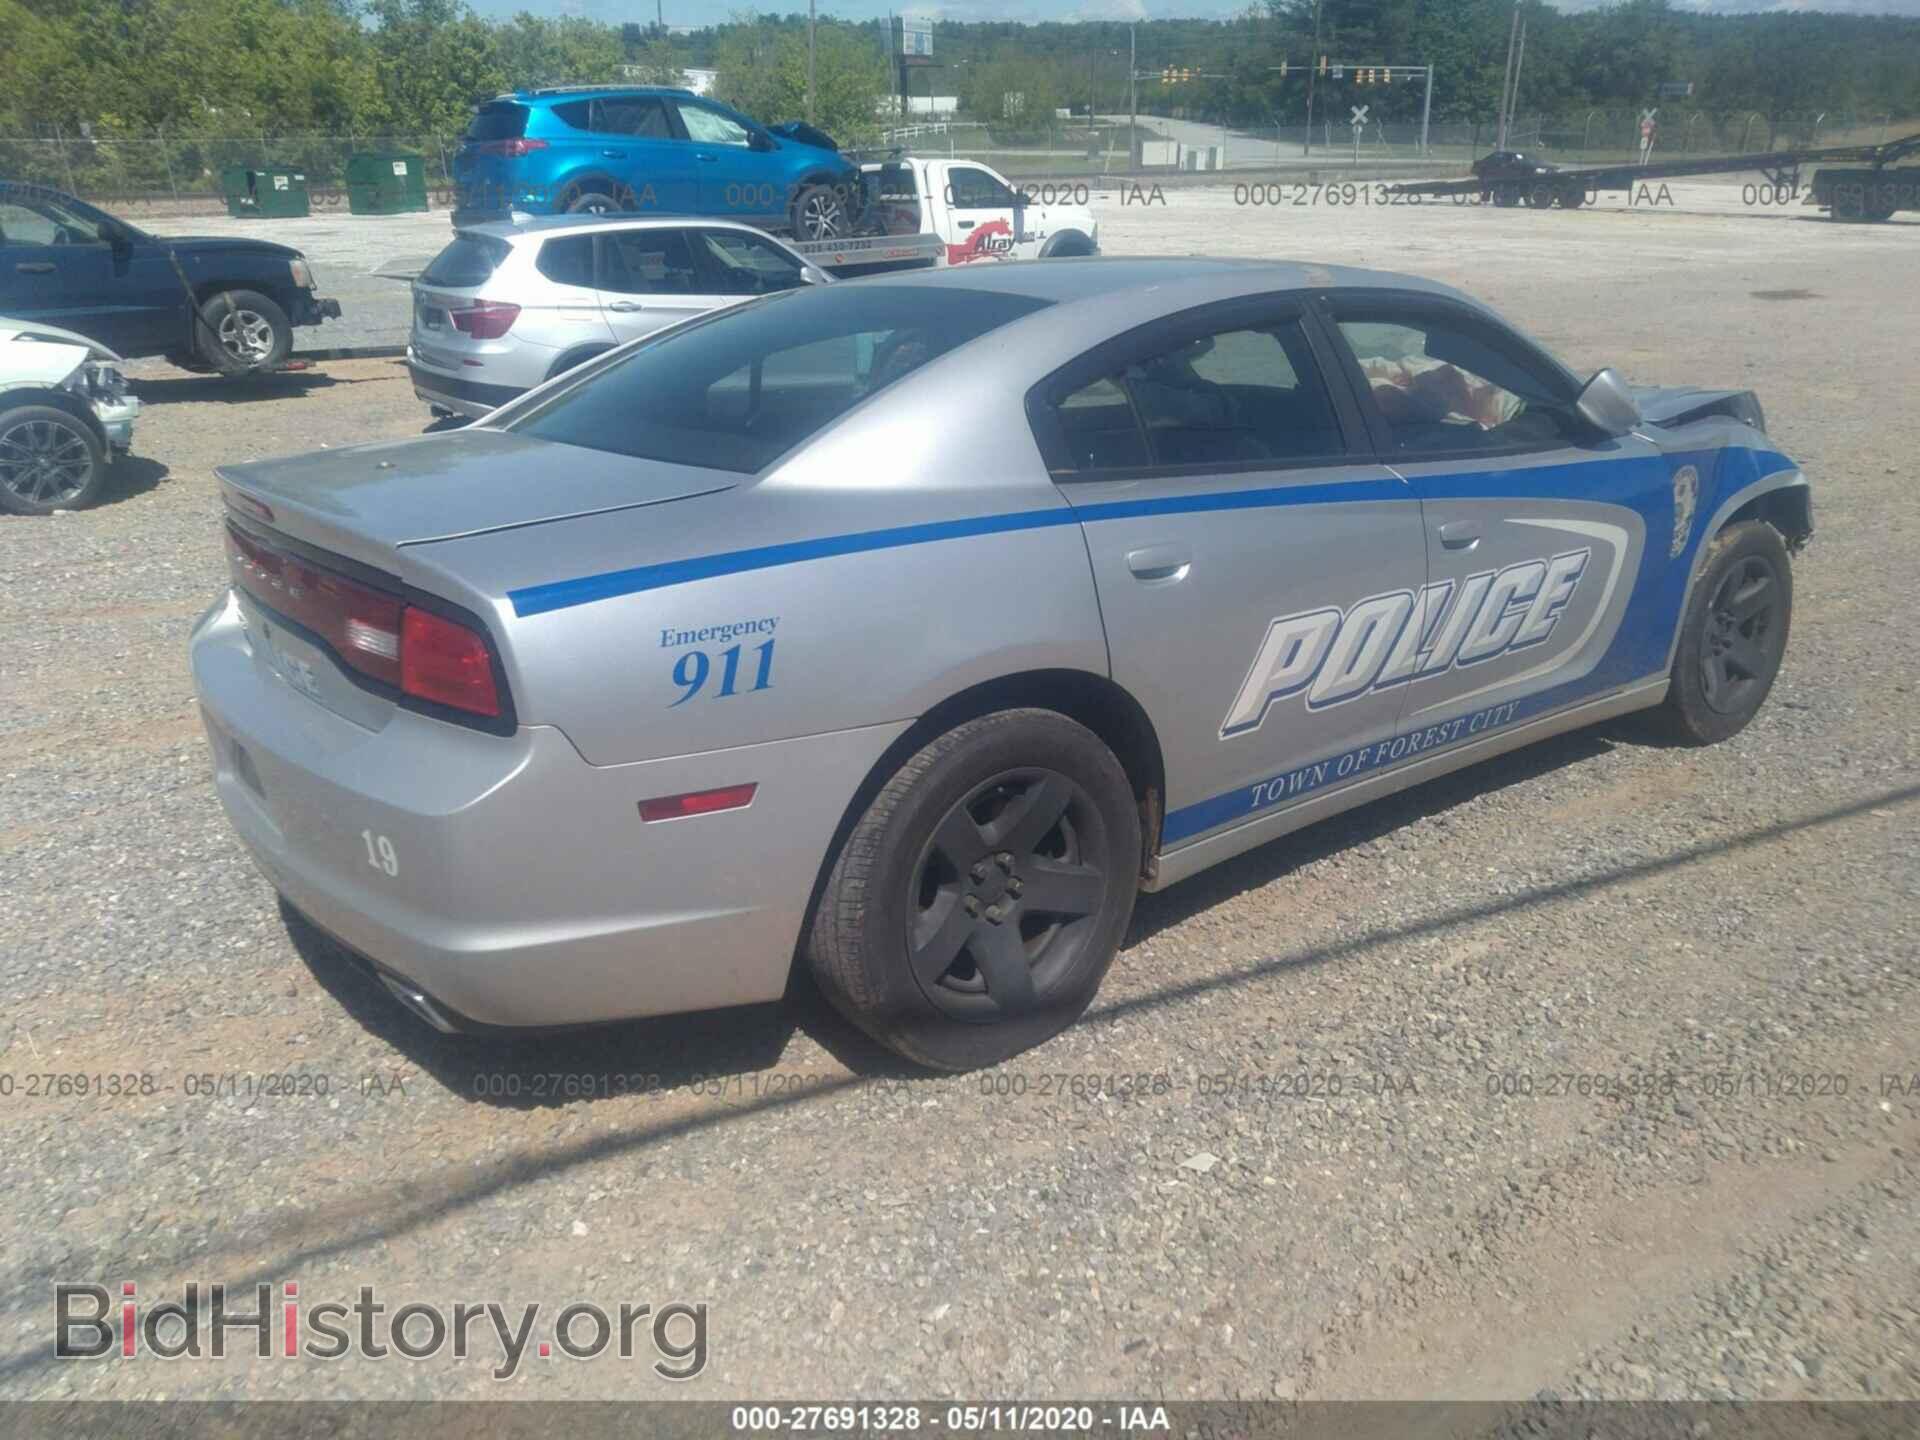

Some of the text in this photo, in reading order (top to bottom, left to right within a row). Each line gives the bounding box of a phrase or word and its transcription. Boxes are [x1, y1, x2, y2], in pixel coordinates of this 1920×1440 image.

[660, 616, 780, 648] Emergency
[1219, 546, 1591, 740] POLICE
[664, 637, 775, 708] 911
[1251, 701, 1520, 808] TOWN OF FOREST CITY
[361, 828, 399, 877] 19
